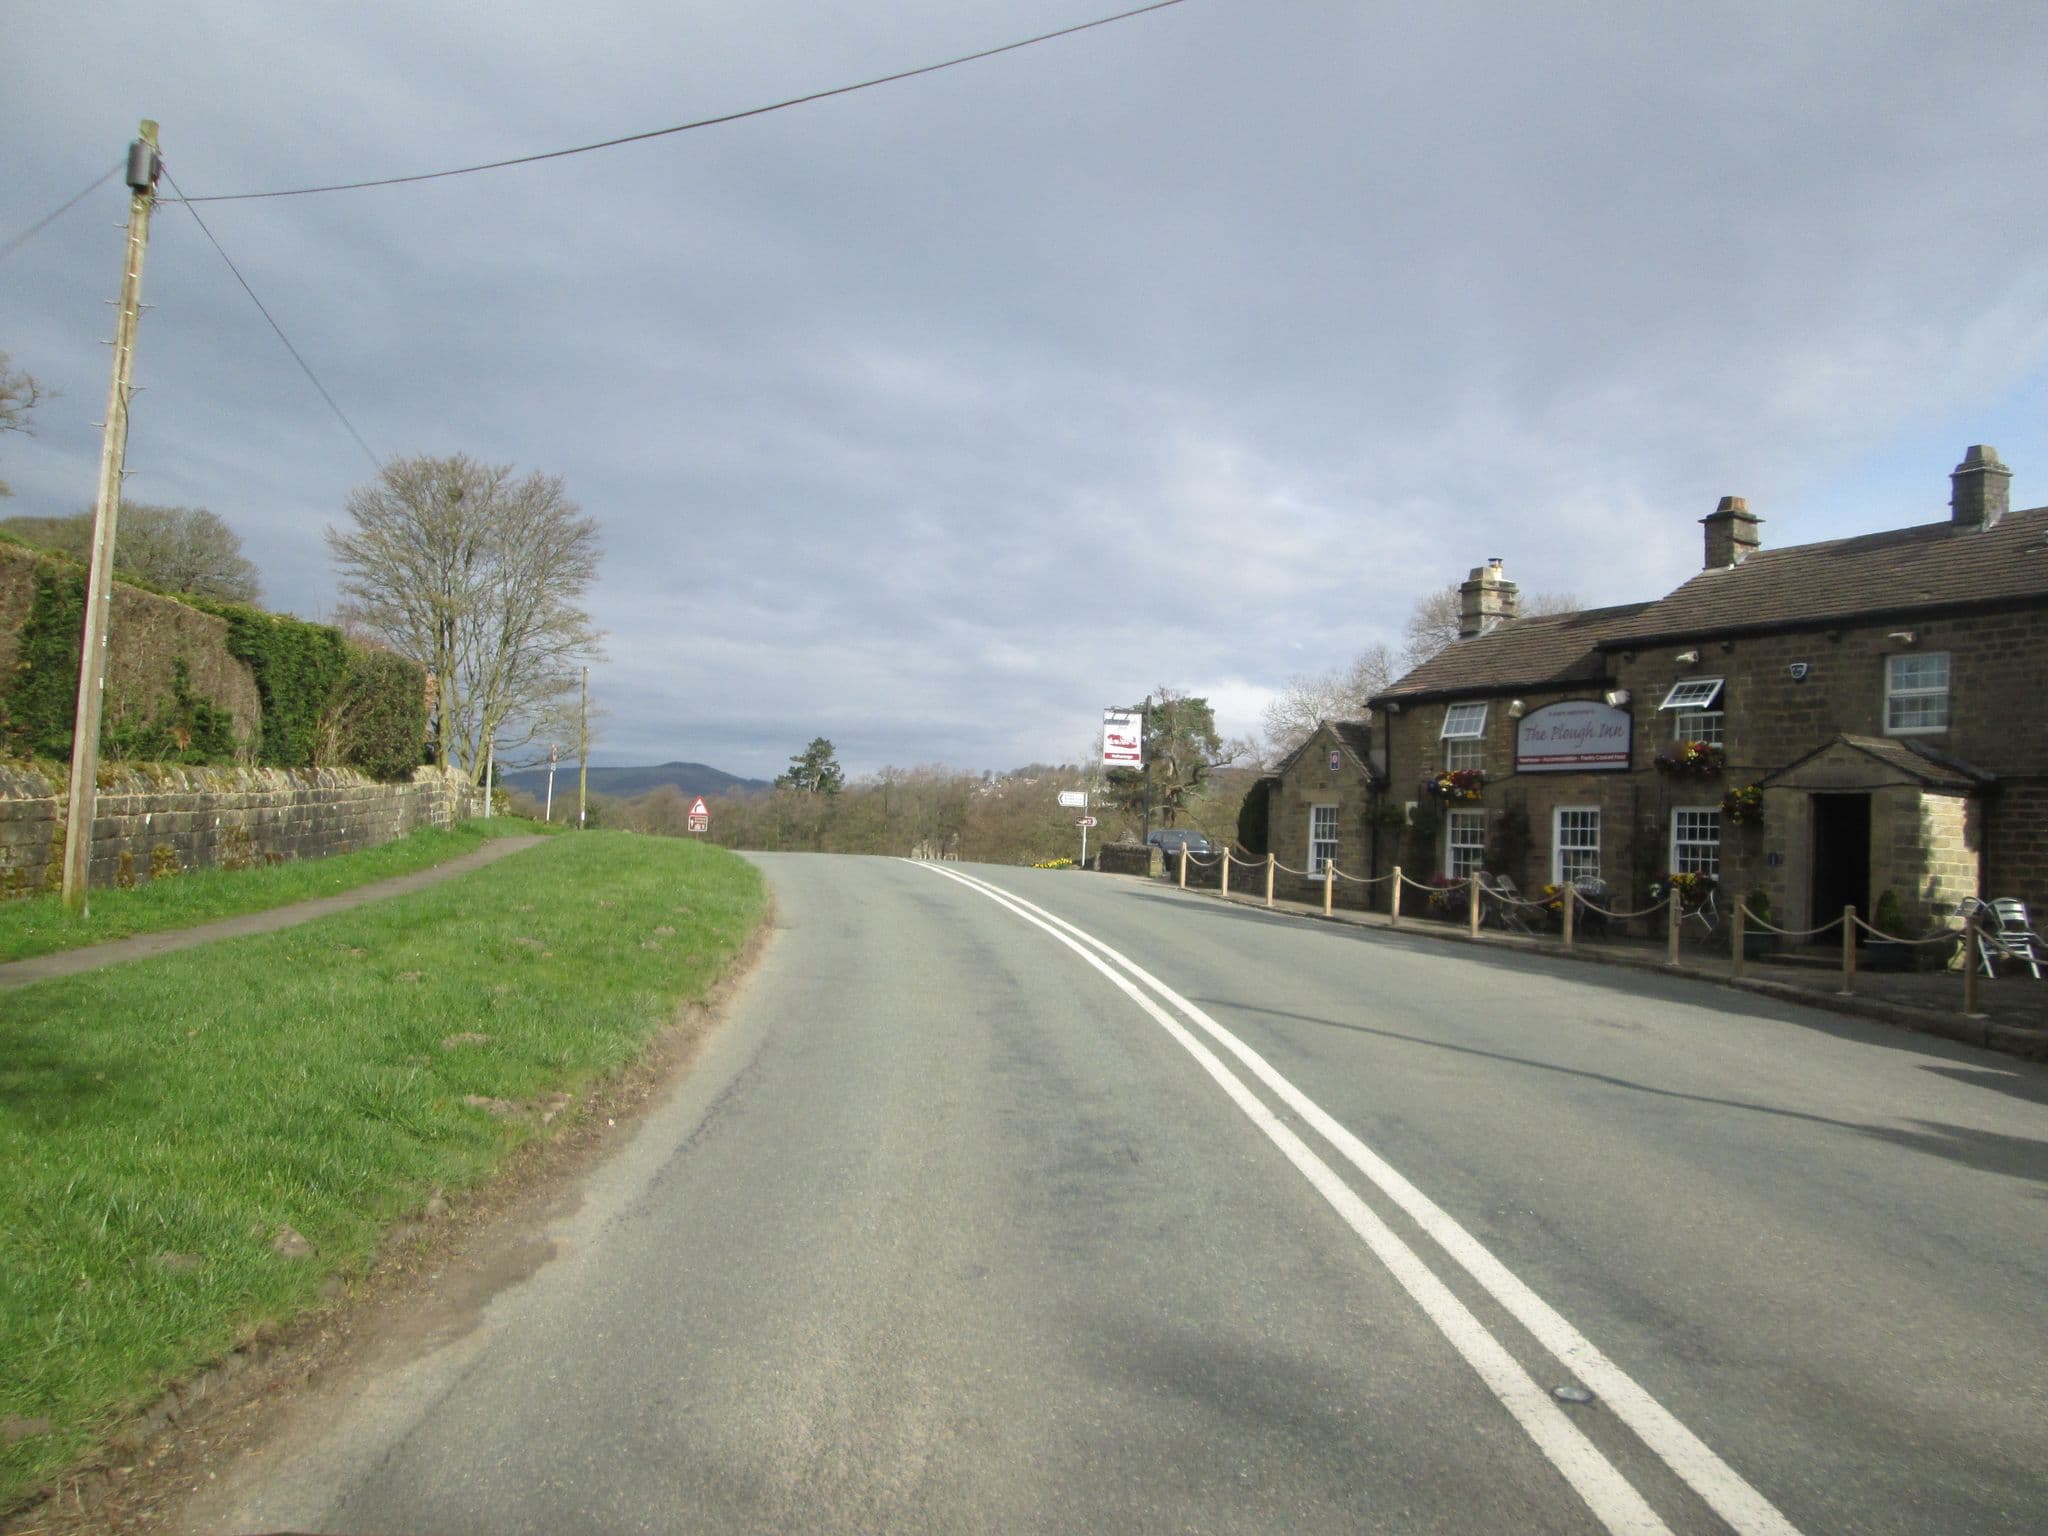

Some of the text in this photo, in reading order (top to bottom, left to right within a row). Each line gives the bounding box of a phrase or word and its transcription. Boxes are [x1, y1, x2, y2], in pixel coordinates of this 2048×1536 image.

[1525, 720, 1624, 748] The Plough Inn
